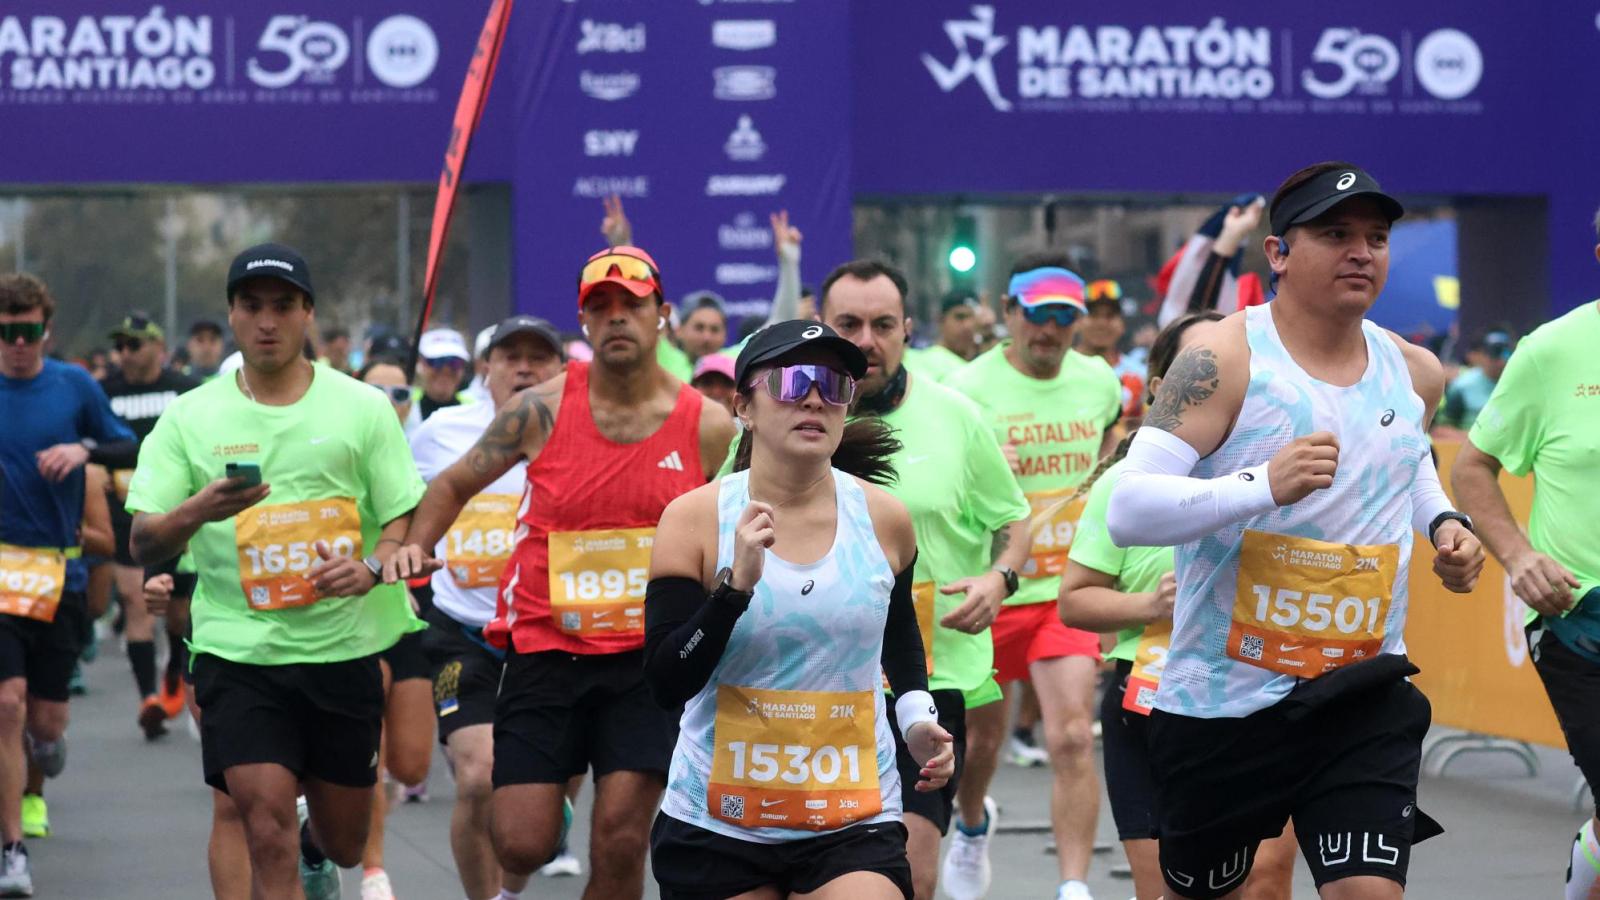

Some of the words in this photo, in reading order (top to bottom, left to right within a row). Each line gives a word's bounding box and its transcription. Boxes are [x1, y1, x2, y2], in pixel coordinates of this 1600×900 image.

[1017, 16, 1271, 67] MARATÓN
[11, 57, 216, 90] SANTIAGO
[1018, 67, 1071, 98] DE
[1077, 67, 1274, 98] SANTIAGO
[246, 259, 294, 272] SALOMON
[1289, 556, 1301, 566] DE
[1302, 558, 1342, 571] SANTIAGO
[1290, 549, 1343, 564] MARATÓN
[559, 567, 649, 601] 1895
[1252, 584, 1382, 635] 15501
[762, 702, 816, 713] MARATÓN
[830, 704, 856, 719] 21K
[775, 711, 816, 720] SANTIAGO
[728, 741, 861, 785] 15301
